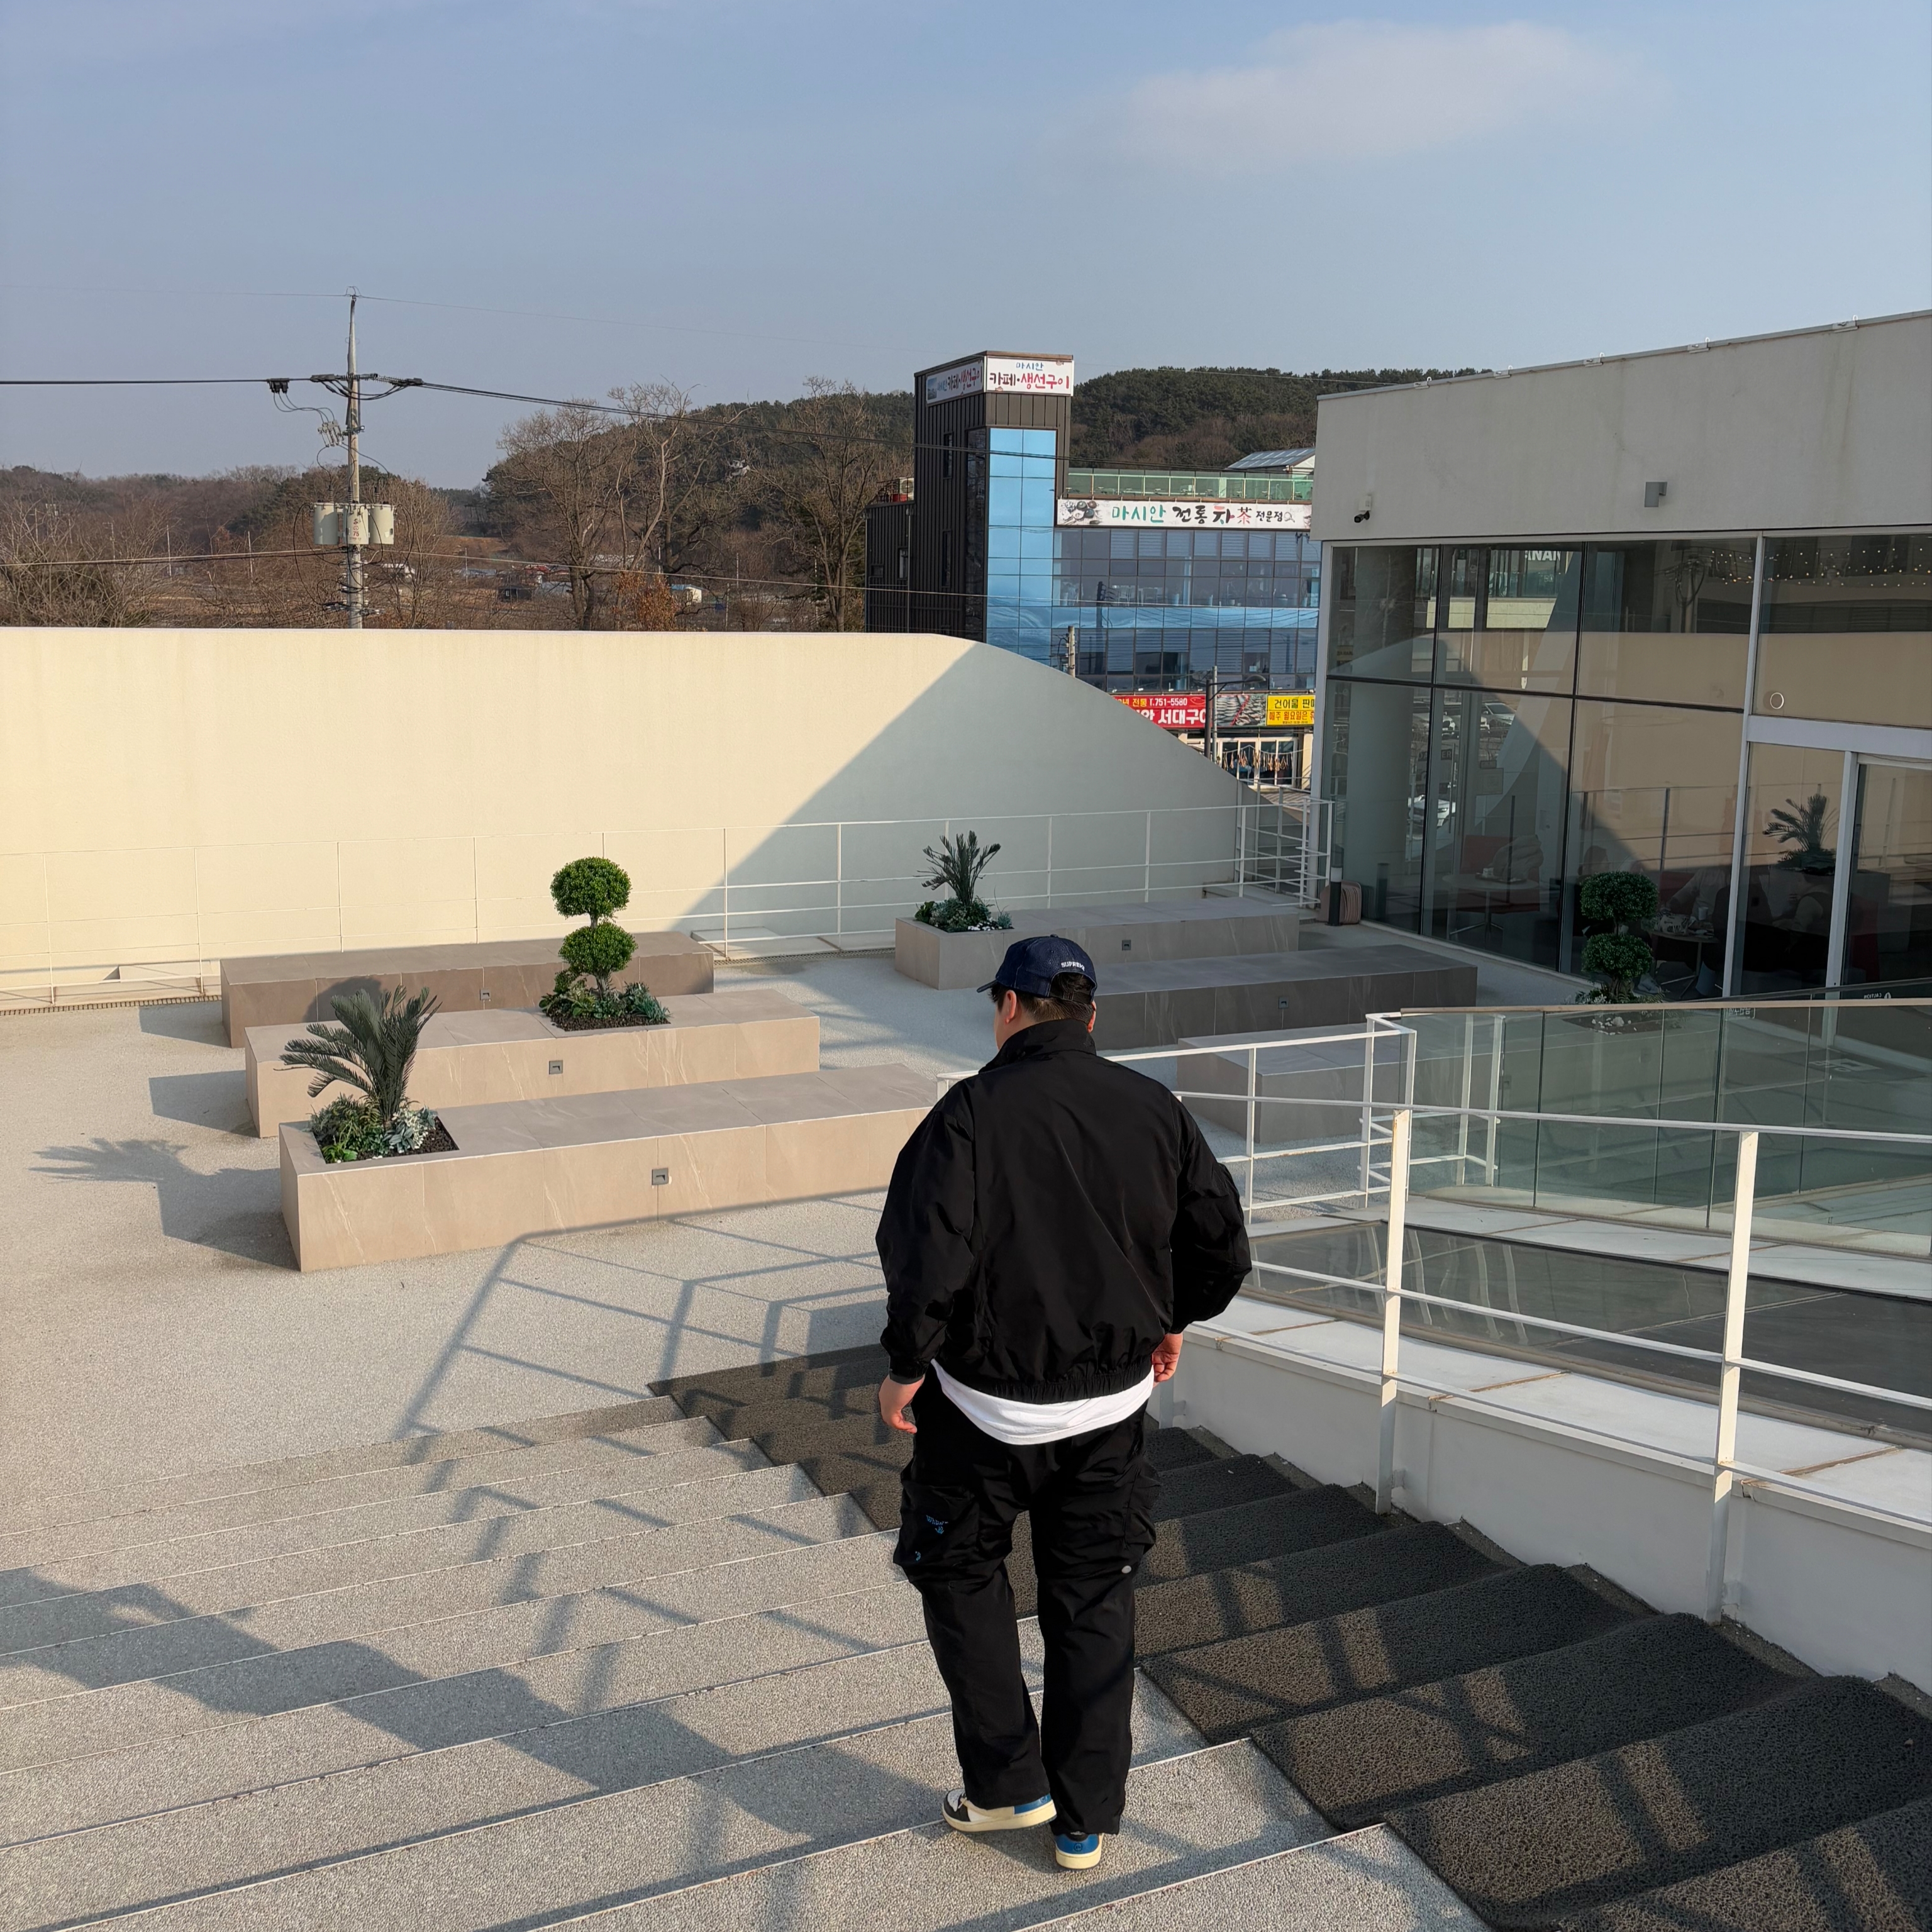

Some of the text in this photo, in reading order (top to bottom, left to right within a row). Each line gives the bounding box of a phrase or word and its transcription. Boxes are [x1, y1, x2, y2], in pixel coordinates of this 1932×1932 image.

[1016, 362, 1044, 371] 마시안
[1112, 504, 1166, 523] 마시안
[1256, 510, 1283, 523] 전문점
[1133, 698, 1147, 707] 전통
[1274, 699, 1299, 709] 건어물
[1269, 711, 1281, 721] 매주
[1284, 711, 1307, 721] 월요일은
